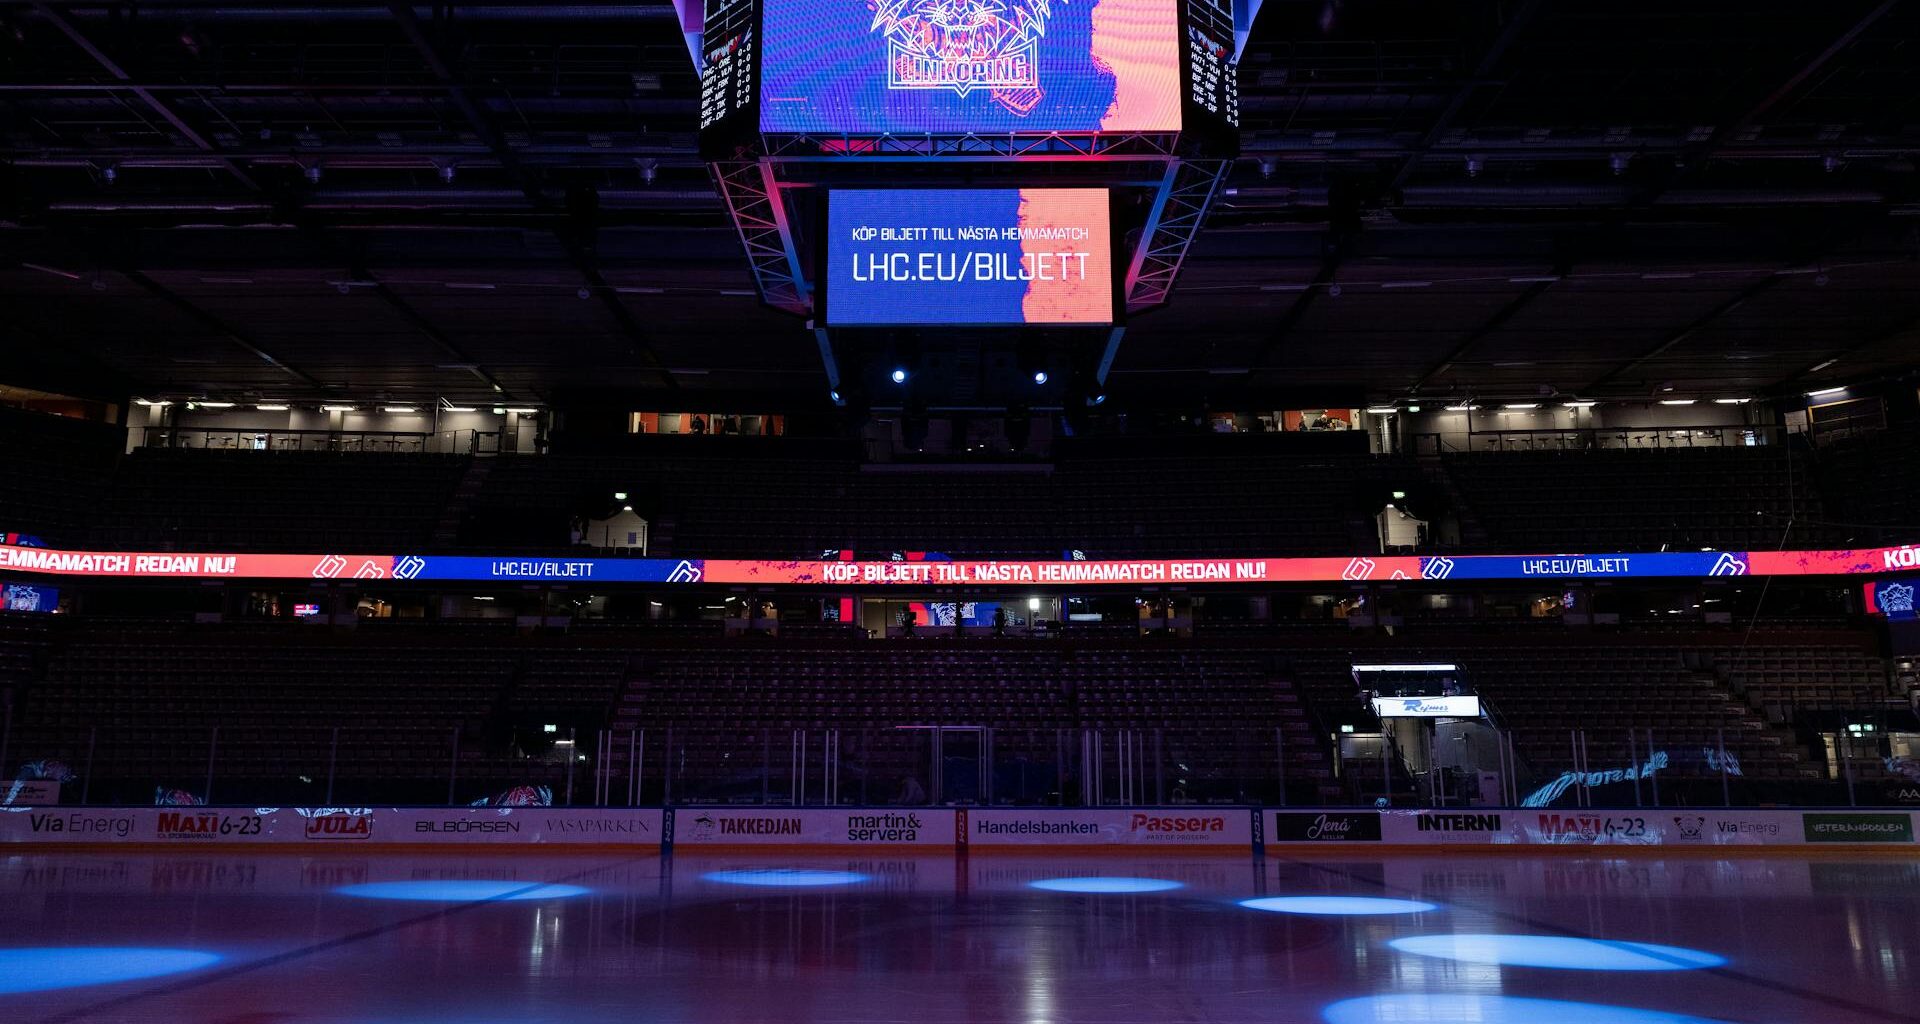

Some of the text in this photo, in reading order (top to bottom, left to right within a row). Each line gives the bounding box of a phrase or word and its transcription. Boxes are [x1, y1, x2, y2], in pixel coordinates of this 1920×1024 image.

[1190, 42, 1202, 55] FHC
[703, 66, 714, 79] FHC
[902, 54, 1026, 82] LINKÖPING
[1191, 52, 1206, 66] HV71
[1210, 64, 1220, 76] VLH
[1192, 62, 1203, 75] RBK
[1206, 72, 1218, 84] FBK
[702, 74, 716, 89] HV71
[721, 64, 732, 78] VLH
[1192, 72, 1202, 84] BIF
[1205, 80, 1216, 92] MIF
[702, 86, 714, 99] RBK
[717, 76, 729, 90] FBK
[1192, 83, 1204, 96] SKE
[1208, 92, 1217, 104] TIK
[702, 97, 712, 109] BIF
[714, 88, 726, 101] MIF
[1193, 93, 1204, 104] LHF
[1208, 102, 1218, 114] DIF
[702, 107, 712, 119] SKE
[716, 98, 726, 110] TIK
[700, 118, 711, 130] LHF
[716, 108, 726, 120] DIF
[853, 226, 1088, 240] KÖP BILJETT TILL NÄSTA HEMMAMATCH
[853, 252, 1090, 282] LHC.EU/BILJETT
[135, 556, 198, 572] REDAN
[204, 556, 236, 573] NU!
[824, 562, 1266, 581] KÖP BILJETT TILL NÄSTA HEMMAMATCH REDAN NU!
[1522, 558, 1629, 574] LHC.EU/BILJETT
[30, 814, 136, 836] Via Energi
[220, 816, 262, 835] 6-23
[308, 817, 368, 834] JULA
[416, 817, 520, 832] BILBÖRSEN
[546, 819, 649, 832] VASAPARKEN
[720, 818, 800, 834] TAKKEDJAN
[848, 813, 922, 828] martin&
[978, 820, 1098, 834] Handelsbanken
[1131, 814, 1224, 832] Passera
[1418, 814, 1500, 831] INTERNI
[1604, 818, 1646, 836] 6-23
[1717, 822, 1780, 836] Via Energi
[1812, 824, 1904, 832] VETERANPOOLEN
[848, 829, 916, 841] servera
